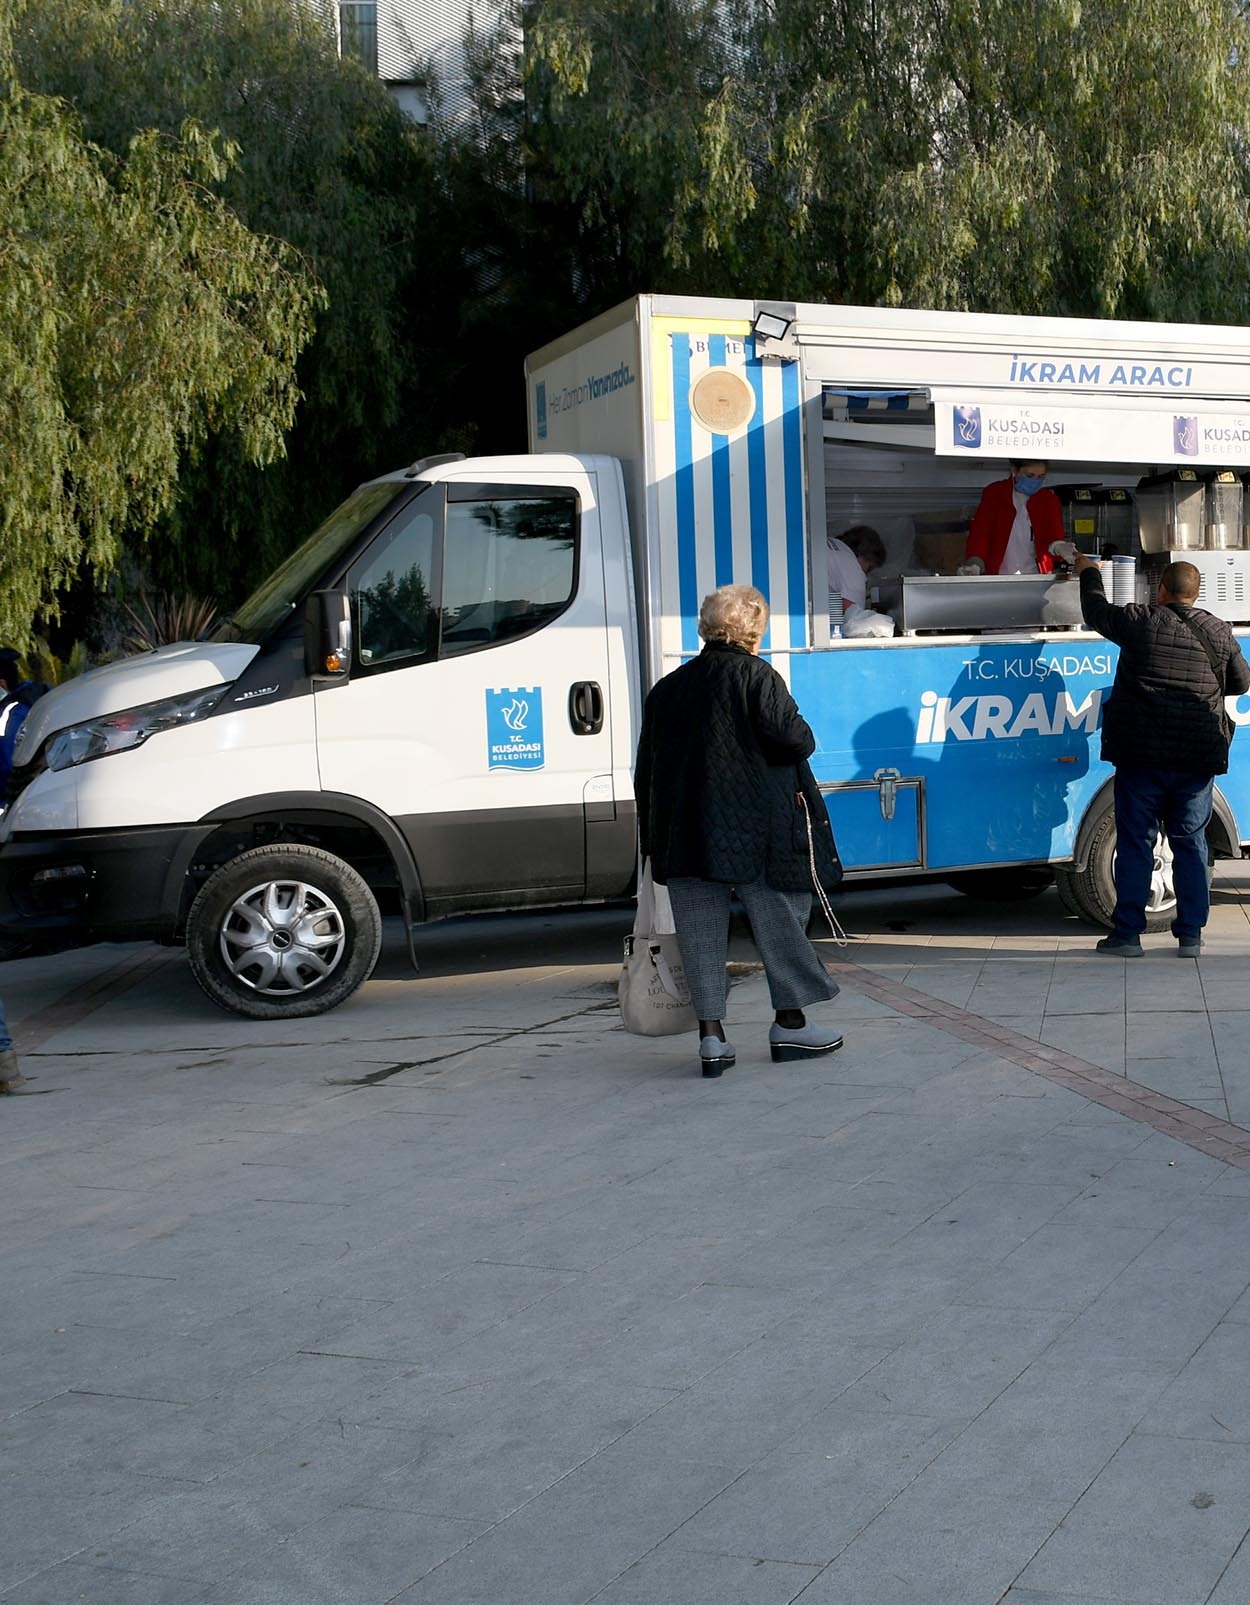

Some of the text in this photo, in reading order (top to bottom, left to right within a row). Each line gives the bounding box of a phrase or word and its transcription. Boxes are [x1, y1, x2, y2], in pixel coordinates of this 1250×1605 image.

[1009, 353, 1192, 387] İKRAM ARACI
[988, 419, 1065, 435] KUŞADASI
[962, 655, 1111, 682] T.C. KUŞADASI
[492, 752, 541, 761] BELEDİYESİ
